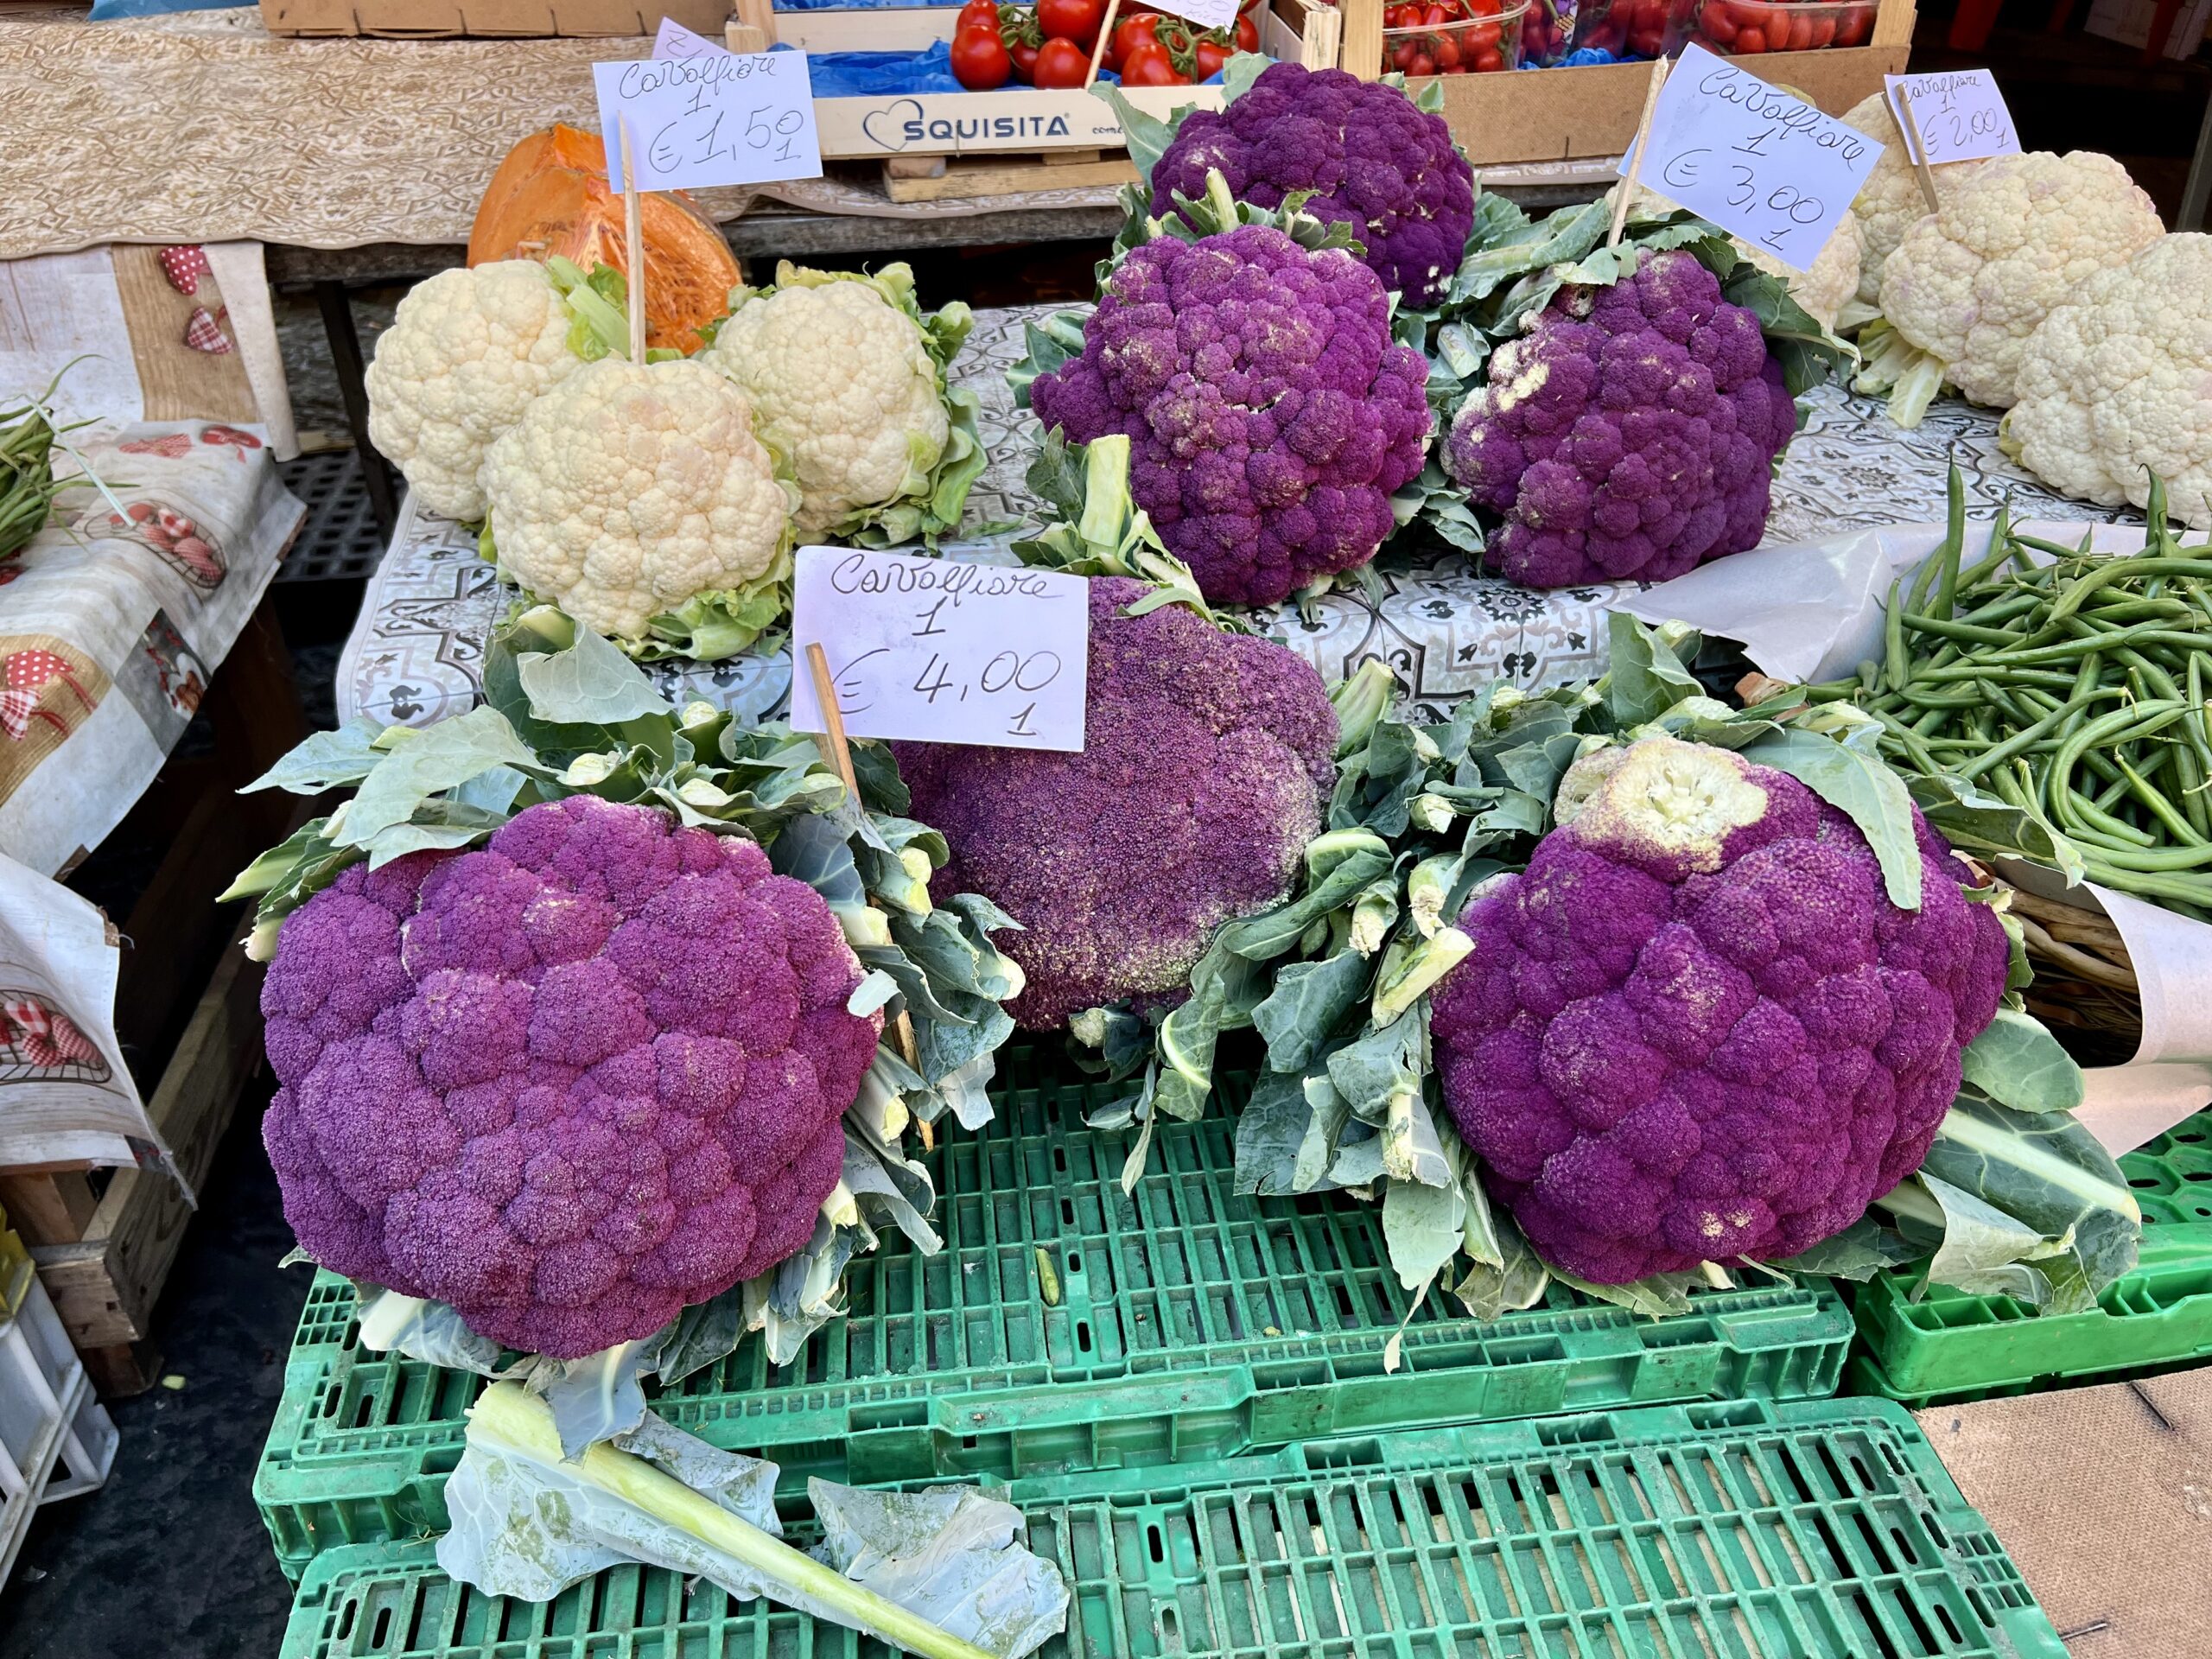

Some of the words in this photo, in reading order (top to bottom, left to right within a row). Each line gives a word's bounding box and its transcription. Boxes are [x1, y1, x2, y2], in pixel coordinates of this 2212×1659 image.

[684, 85, 711, 116] 1
[903, 116, 1070, 141] SQUISITA
[1731, 127, 1777, 156] 1
[912, 596, 946, 635] 1
